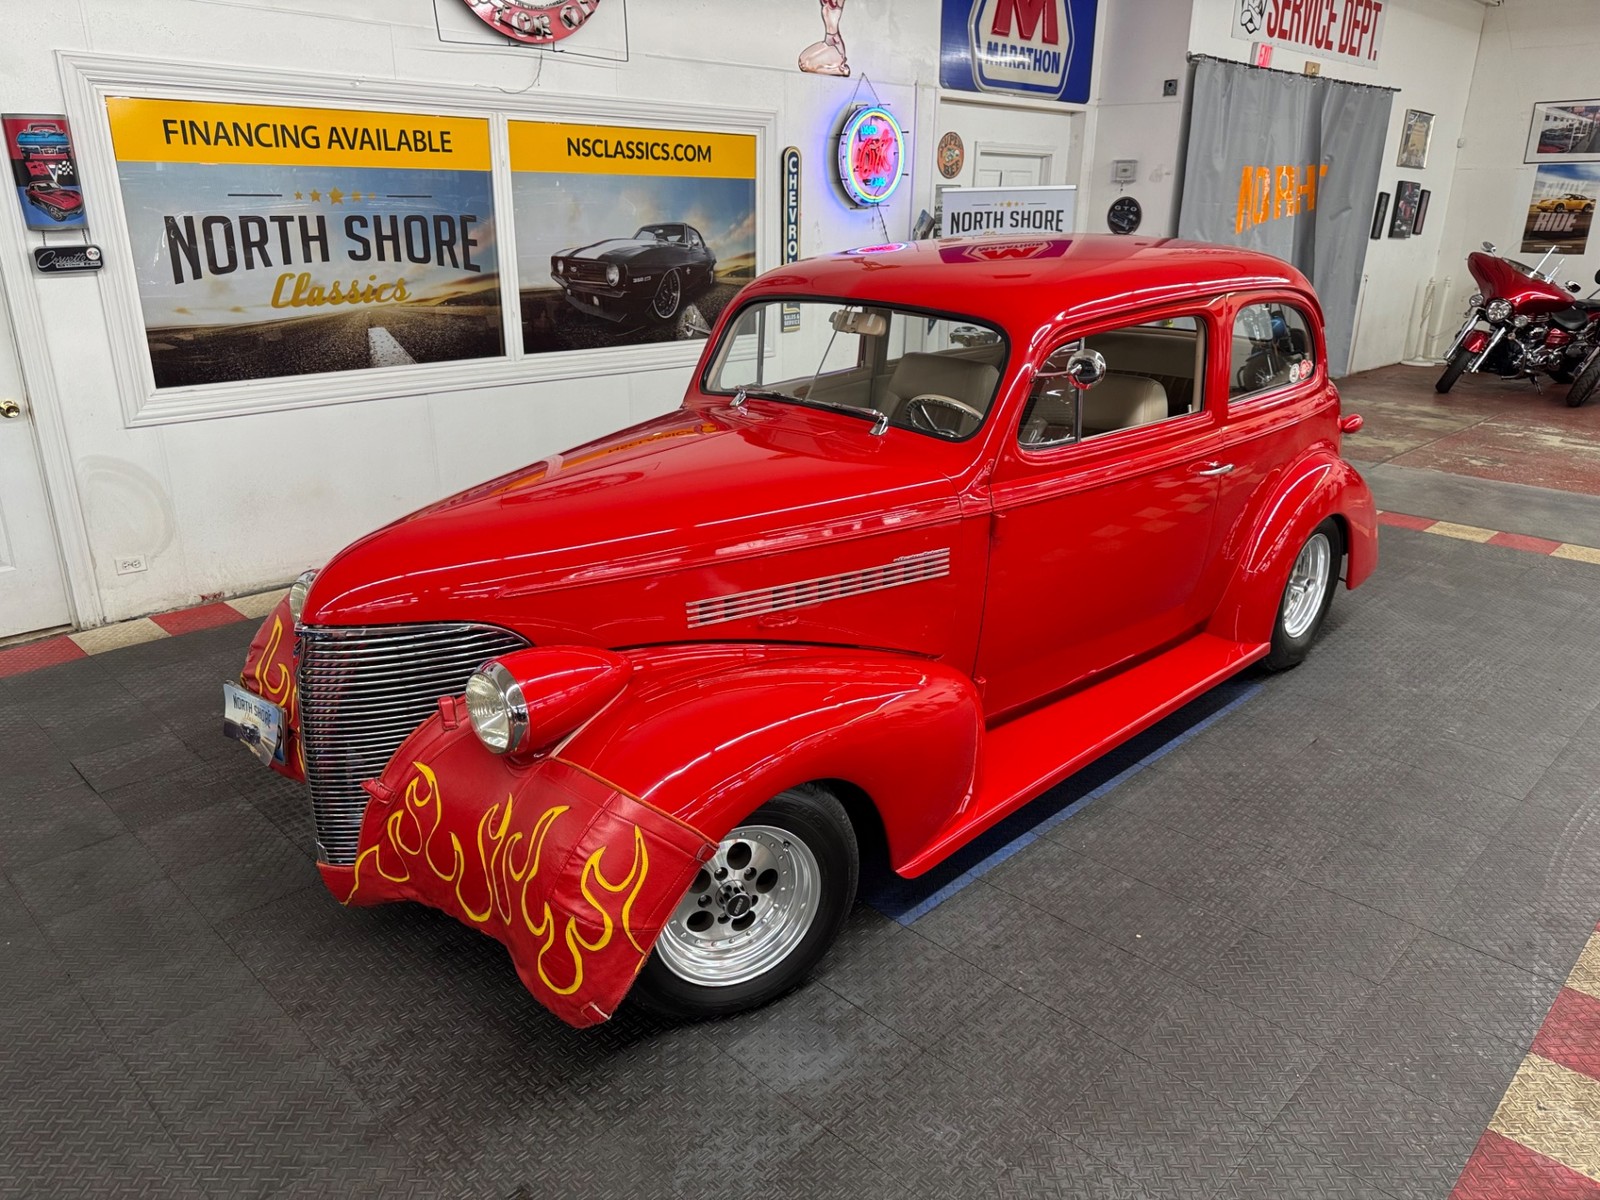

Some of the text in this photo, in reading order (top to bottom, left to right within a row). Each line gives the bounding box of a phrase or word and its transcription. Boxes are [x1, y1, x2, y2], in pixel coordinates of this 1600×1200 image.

[1266, 0, 1383, 61] SERVICE DEPT.
[986, 41, 1061, 74] MARATHON
[162, 119, 453, 153] FINANCING AVAILABLE
[567, 137, 712, 163] NSCLASSICS.COM
[1114, 204, 1138, 212] GTO
[950, 211, 1004, 235] NORTH
[1010, 209, 1064, 232] SHORE
[1533, 213, 1577, 232] RIDE
[38, 250, 88, 269] Corvette
[164, 215, 481, 284] NORTH SHORE
[271, 272, 411, 308] Classics
[232, 692, 253, 714] NORTH
